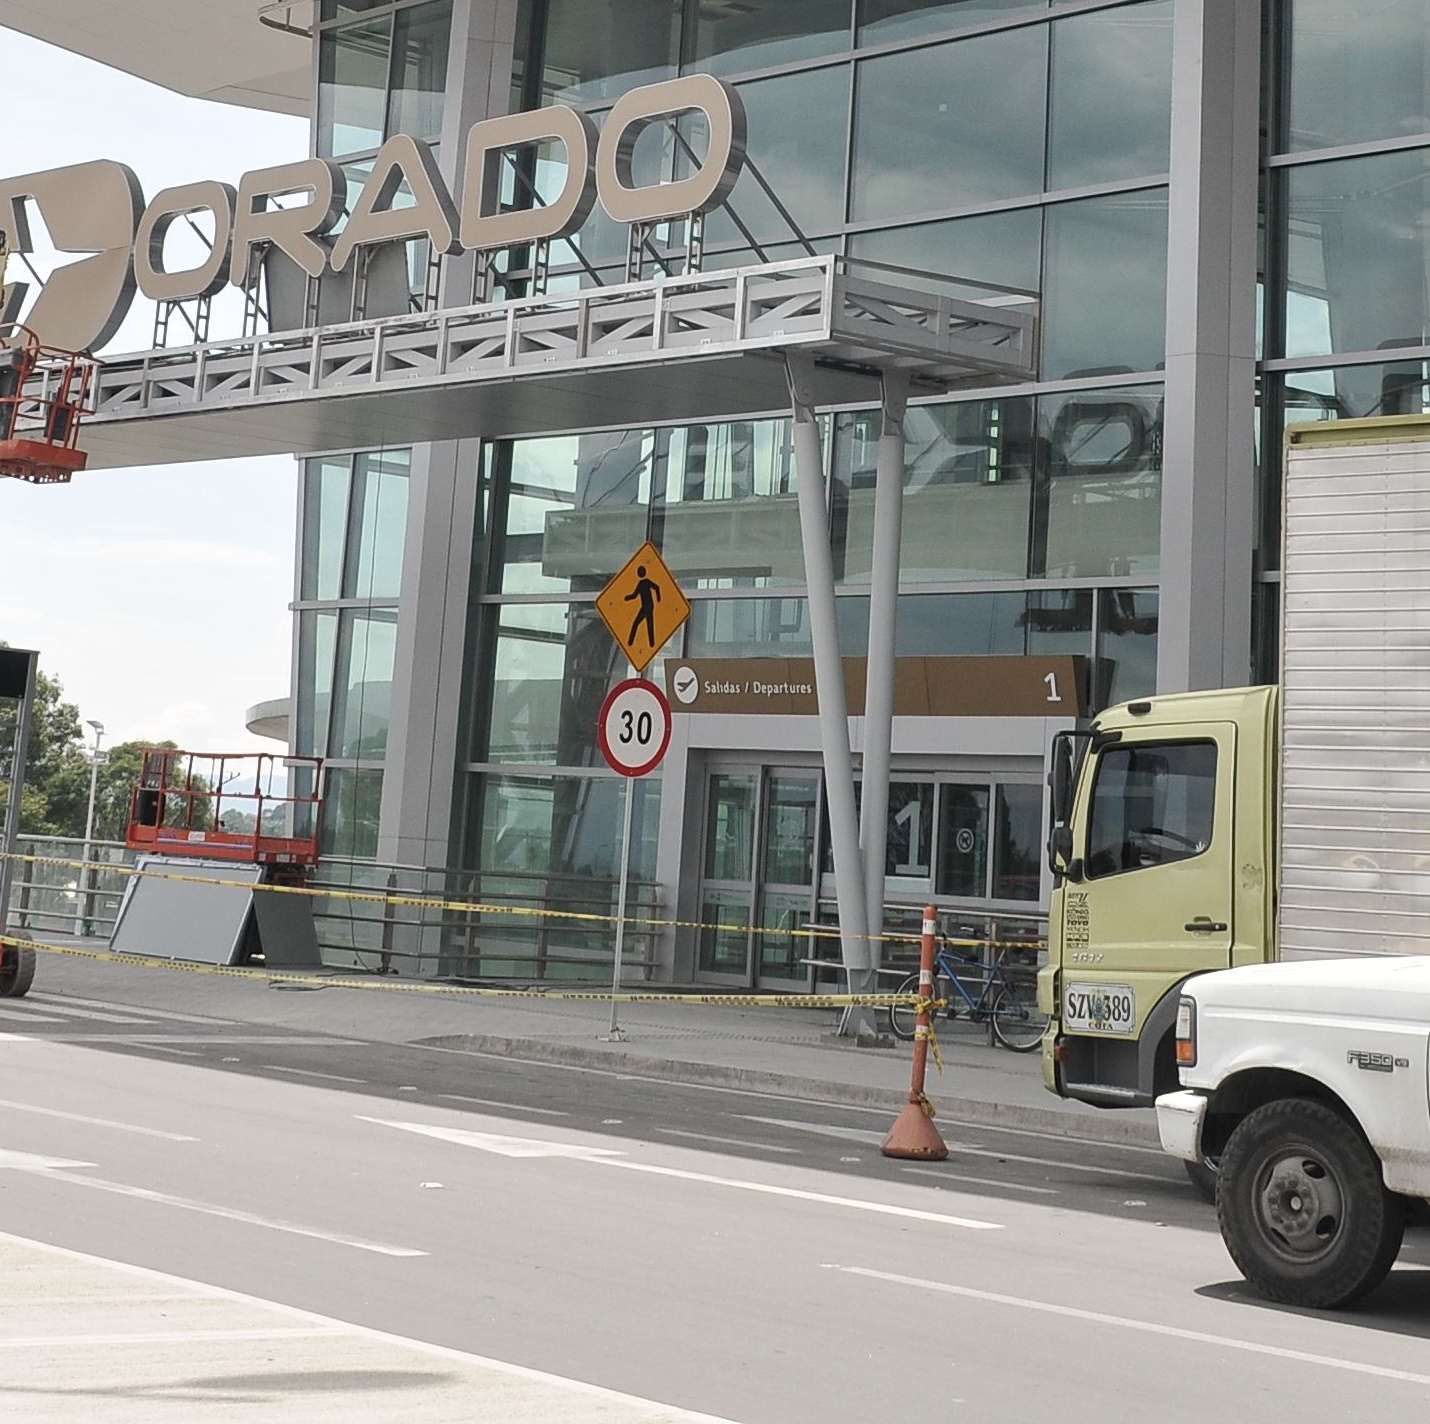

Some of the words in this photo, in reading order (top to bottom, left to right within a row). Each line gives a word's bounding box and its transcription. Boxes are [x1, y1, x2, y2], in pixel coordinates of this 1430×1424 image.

[704, 680, 741, 694] Salidas
[753, 681, 812, 697] Departures
[1044, 672, 1061, 701] 1
[619, 710, 652, 745] 30
[894, 801, 929, 876] 1
